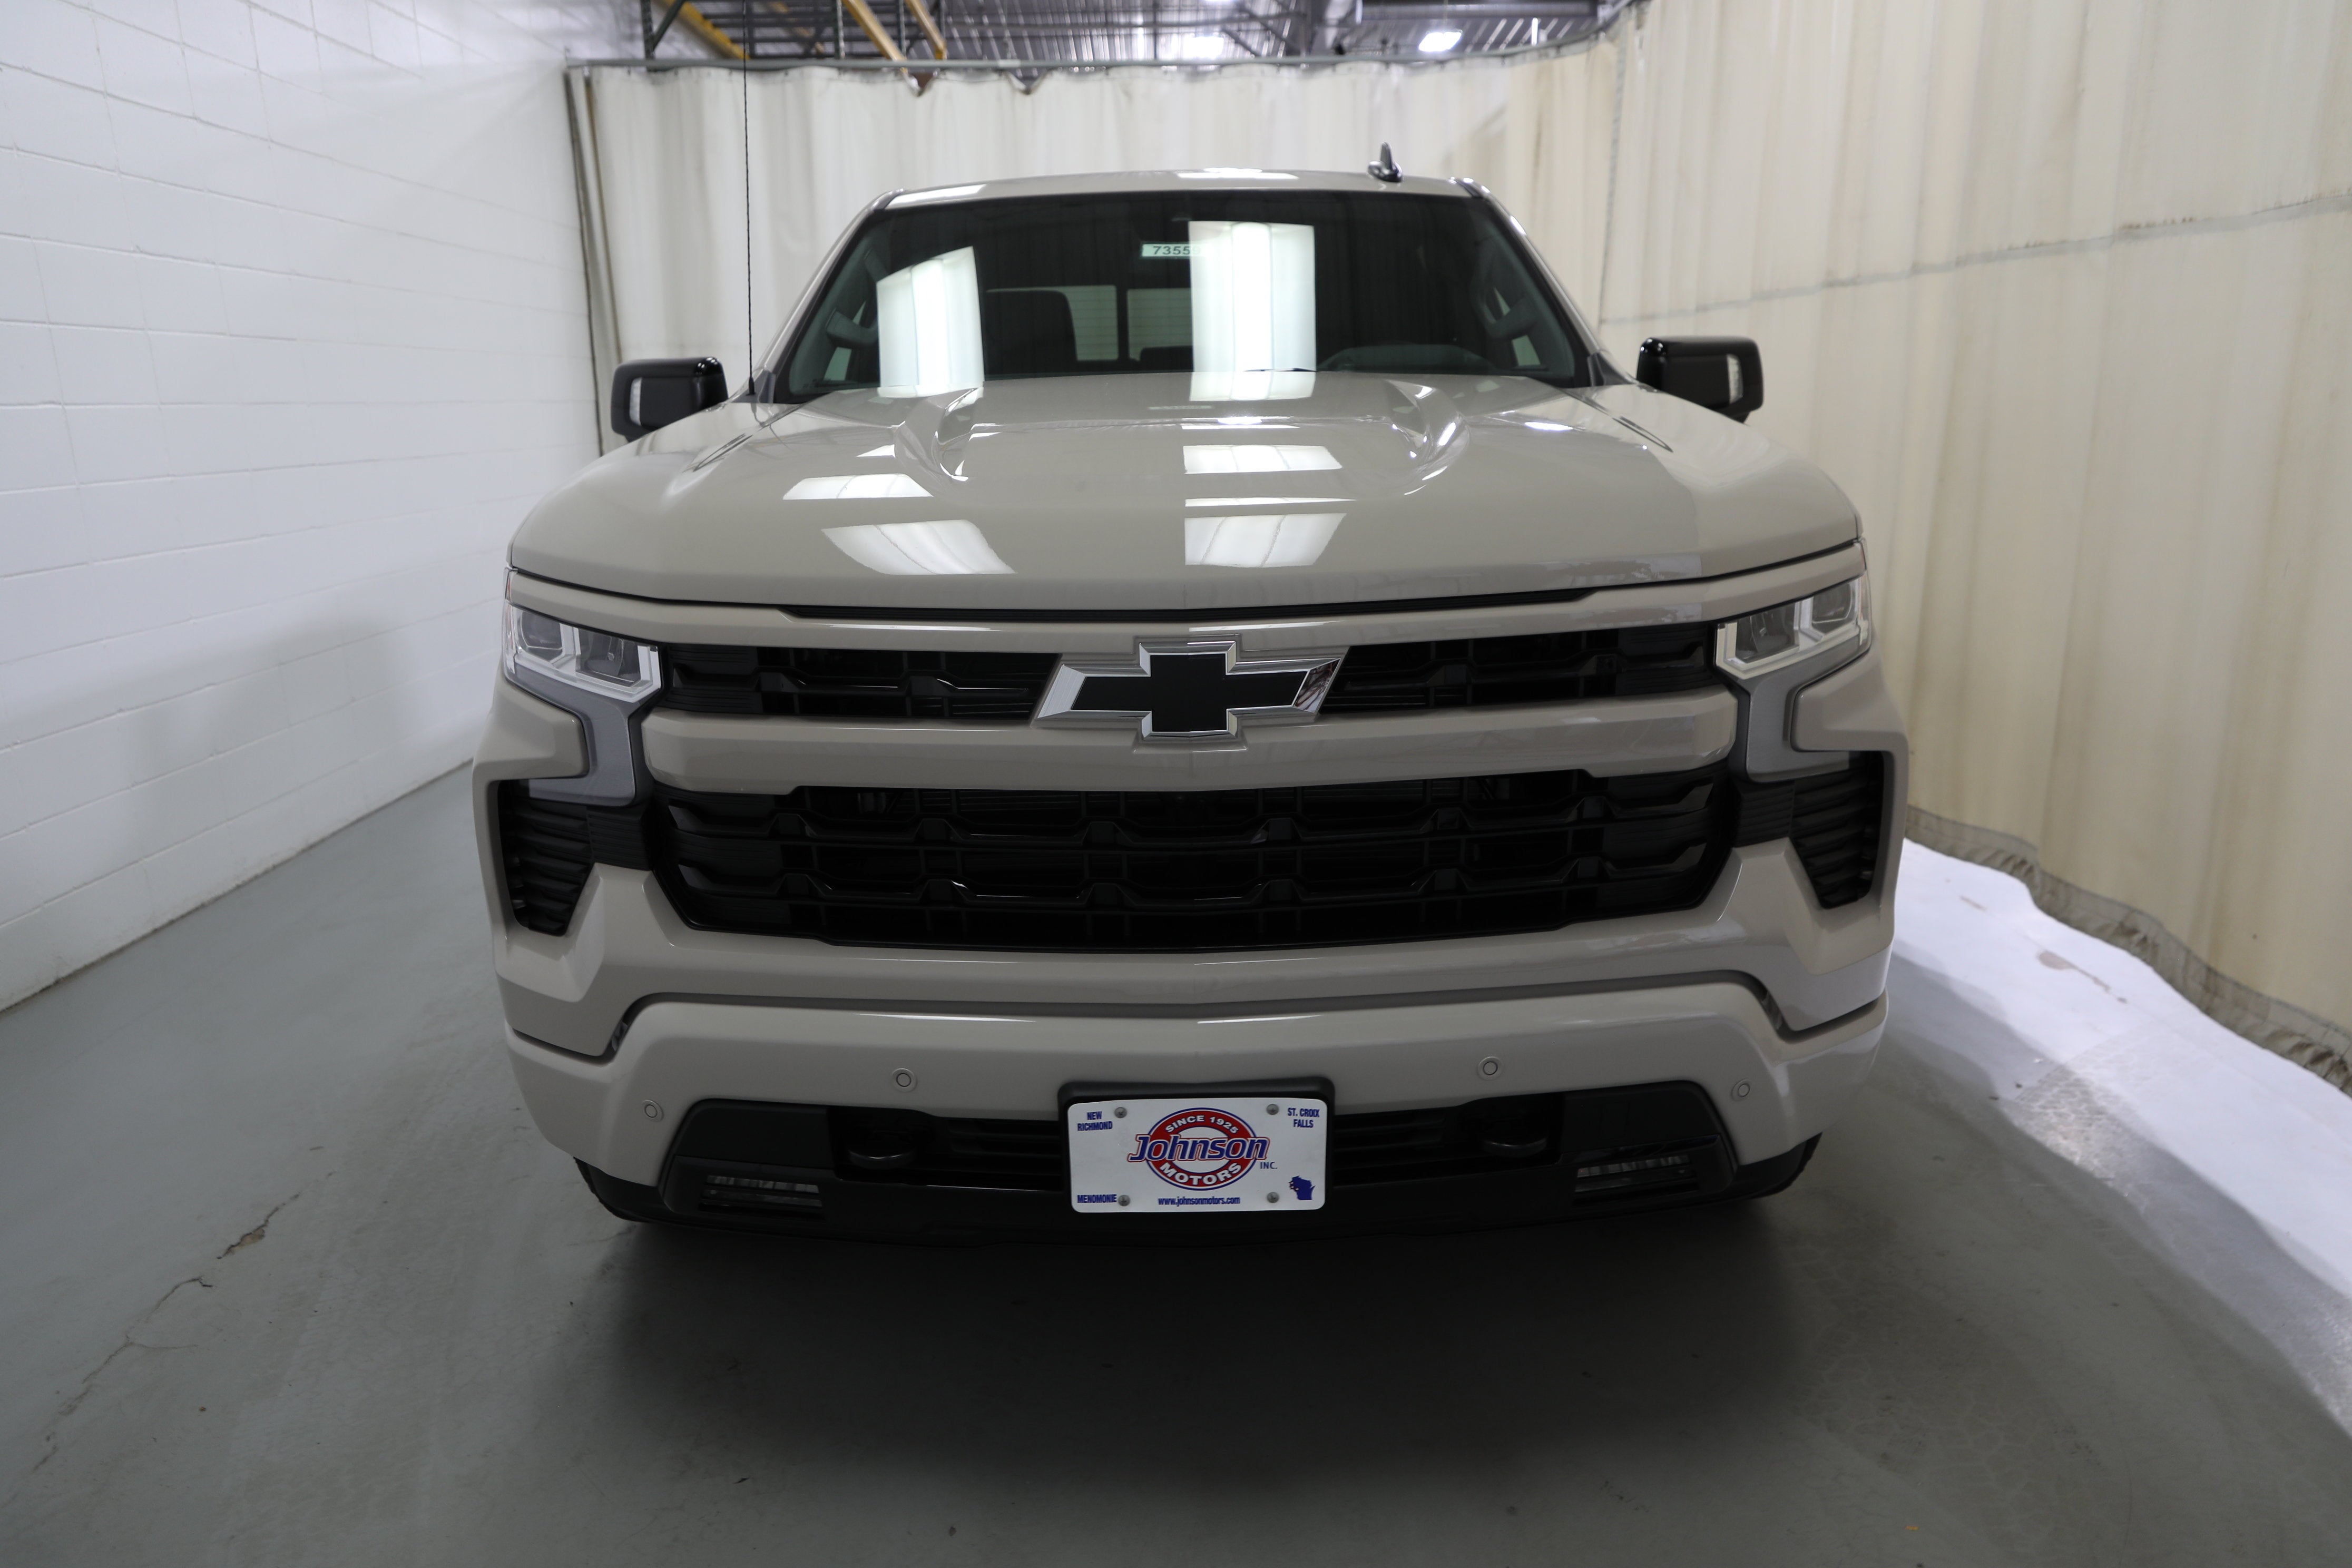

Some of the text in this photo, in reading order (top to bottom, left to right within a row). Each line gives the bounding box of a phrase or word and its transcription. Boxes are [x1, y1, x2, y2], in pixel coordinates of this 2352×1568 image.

[1087, 1111, 1102, 1120] NEW
[1287, 1108, 1320, 1118] ST. CROIX
[1077, 1121, 1113, 1131] RICHMOND
[1165, 1115, 1239, 1133] SINCE 1925
[1293, 1119, 1314, 1128] FALLS
[1129, 1134, 1269, 1161] Johnson
[1159, 1162, 1241, 1185] MOTORS
[1077, 1194, 1117, 1203] MENOMONIE
[1158, 1196, 1241, 1207] www.johnsonmotors.com
